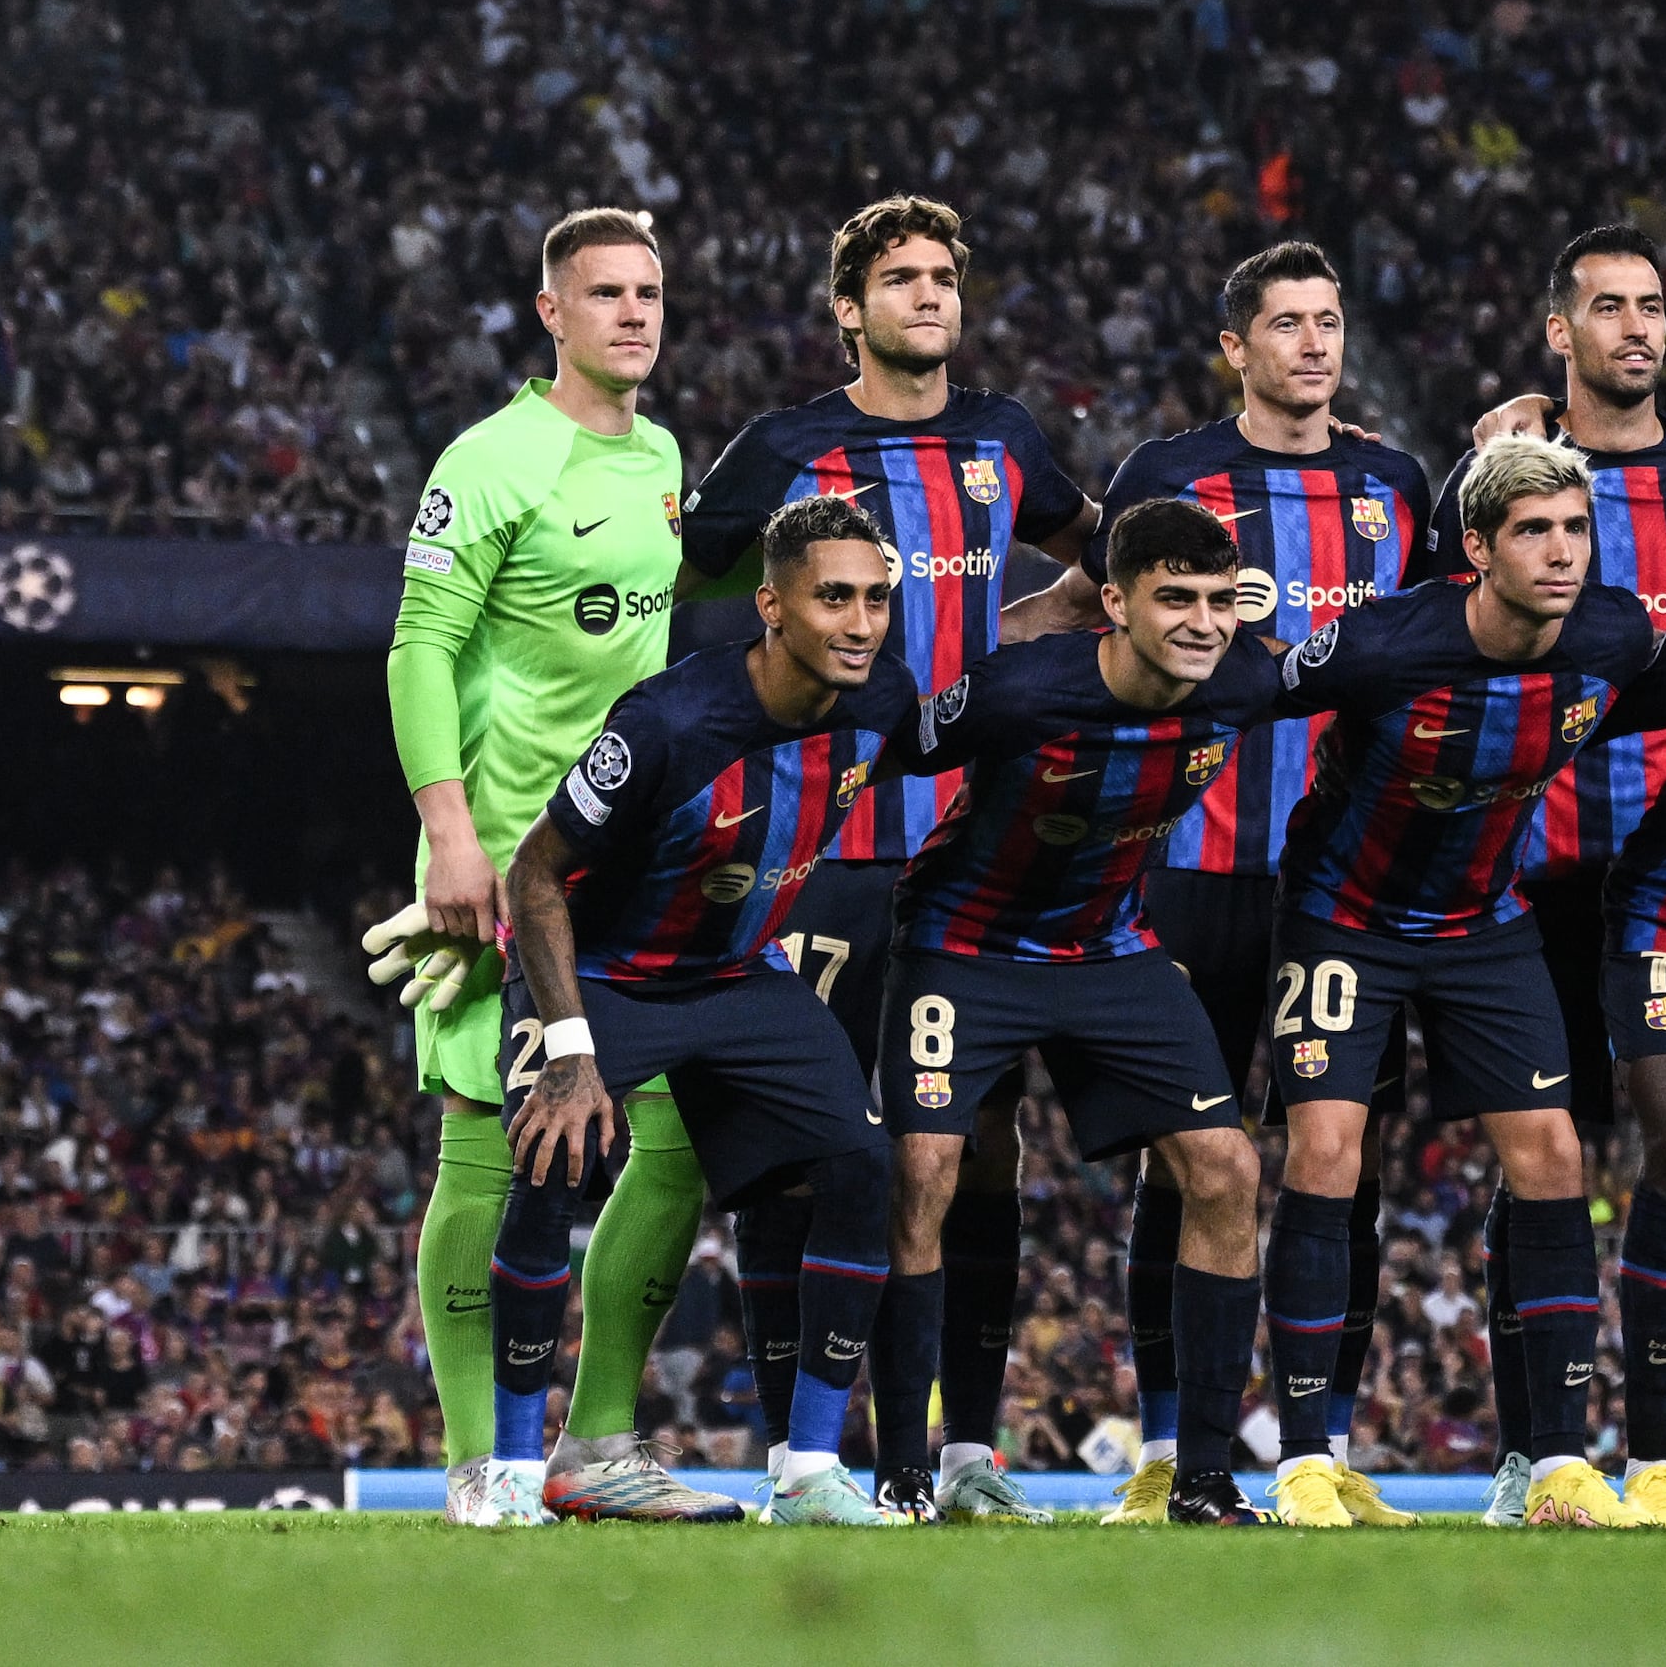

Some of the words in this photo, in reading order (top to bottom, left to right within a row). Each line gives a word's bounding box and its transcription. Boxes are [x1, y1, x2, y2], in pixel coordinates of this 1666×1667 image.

[910, 547, 1000, 582] Spotify
[779, 932, 851, 1006] 17
[1273, 959, 1358, 1039] 20
[506, 1017, 544, 1095] 2
[910, 994, 956, 1068] 8
[1288, 1375, 1328, 1387] barça
